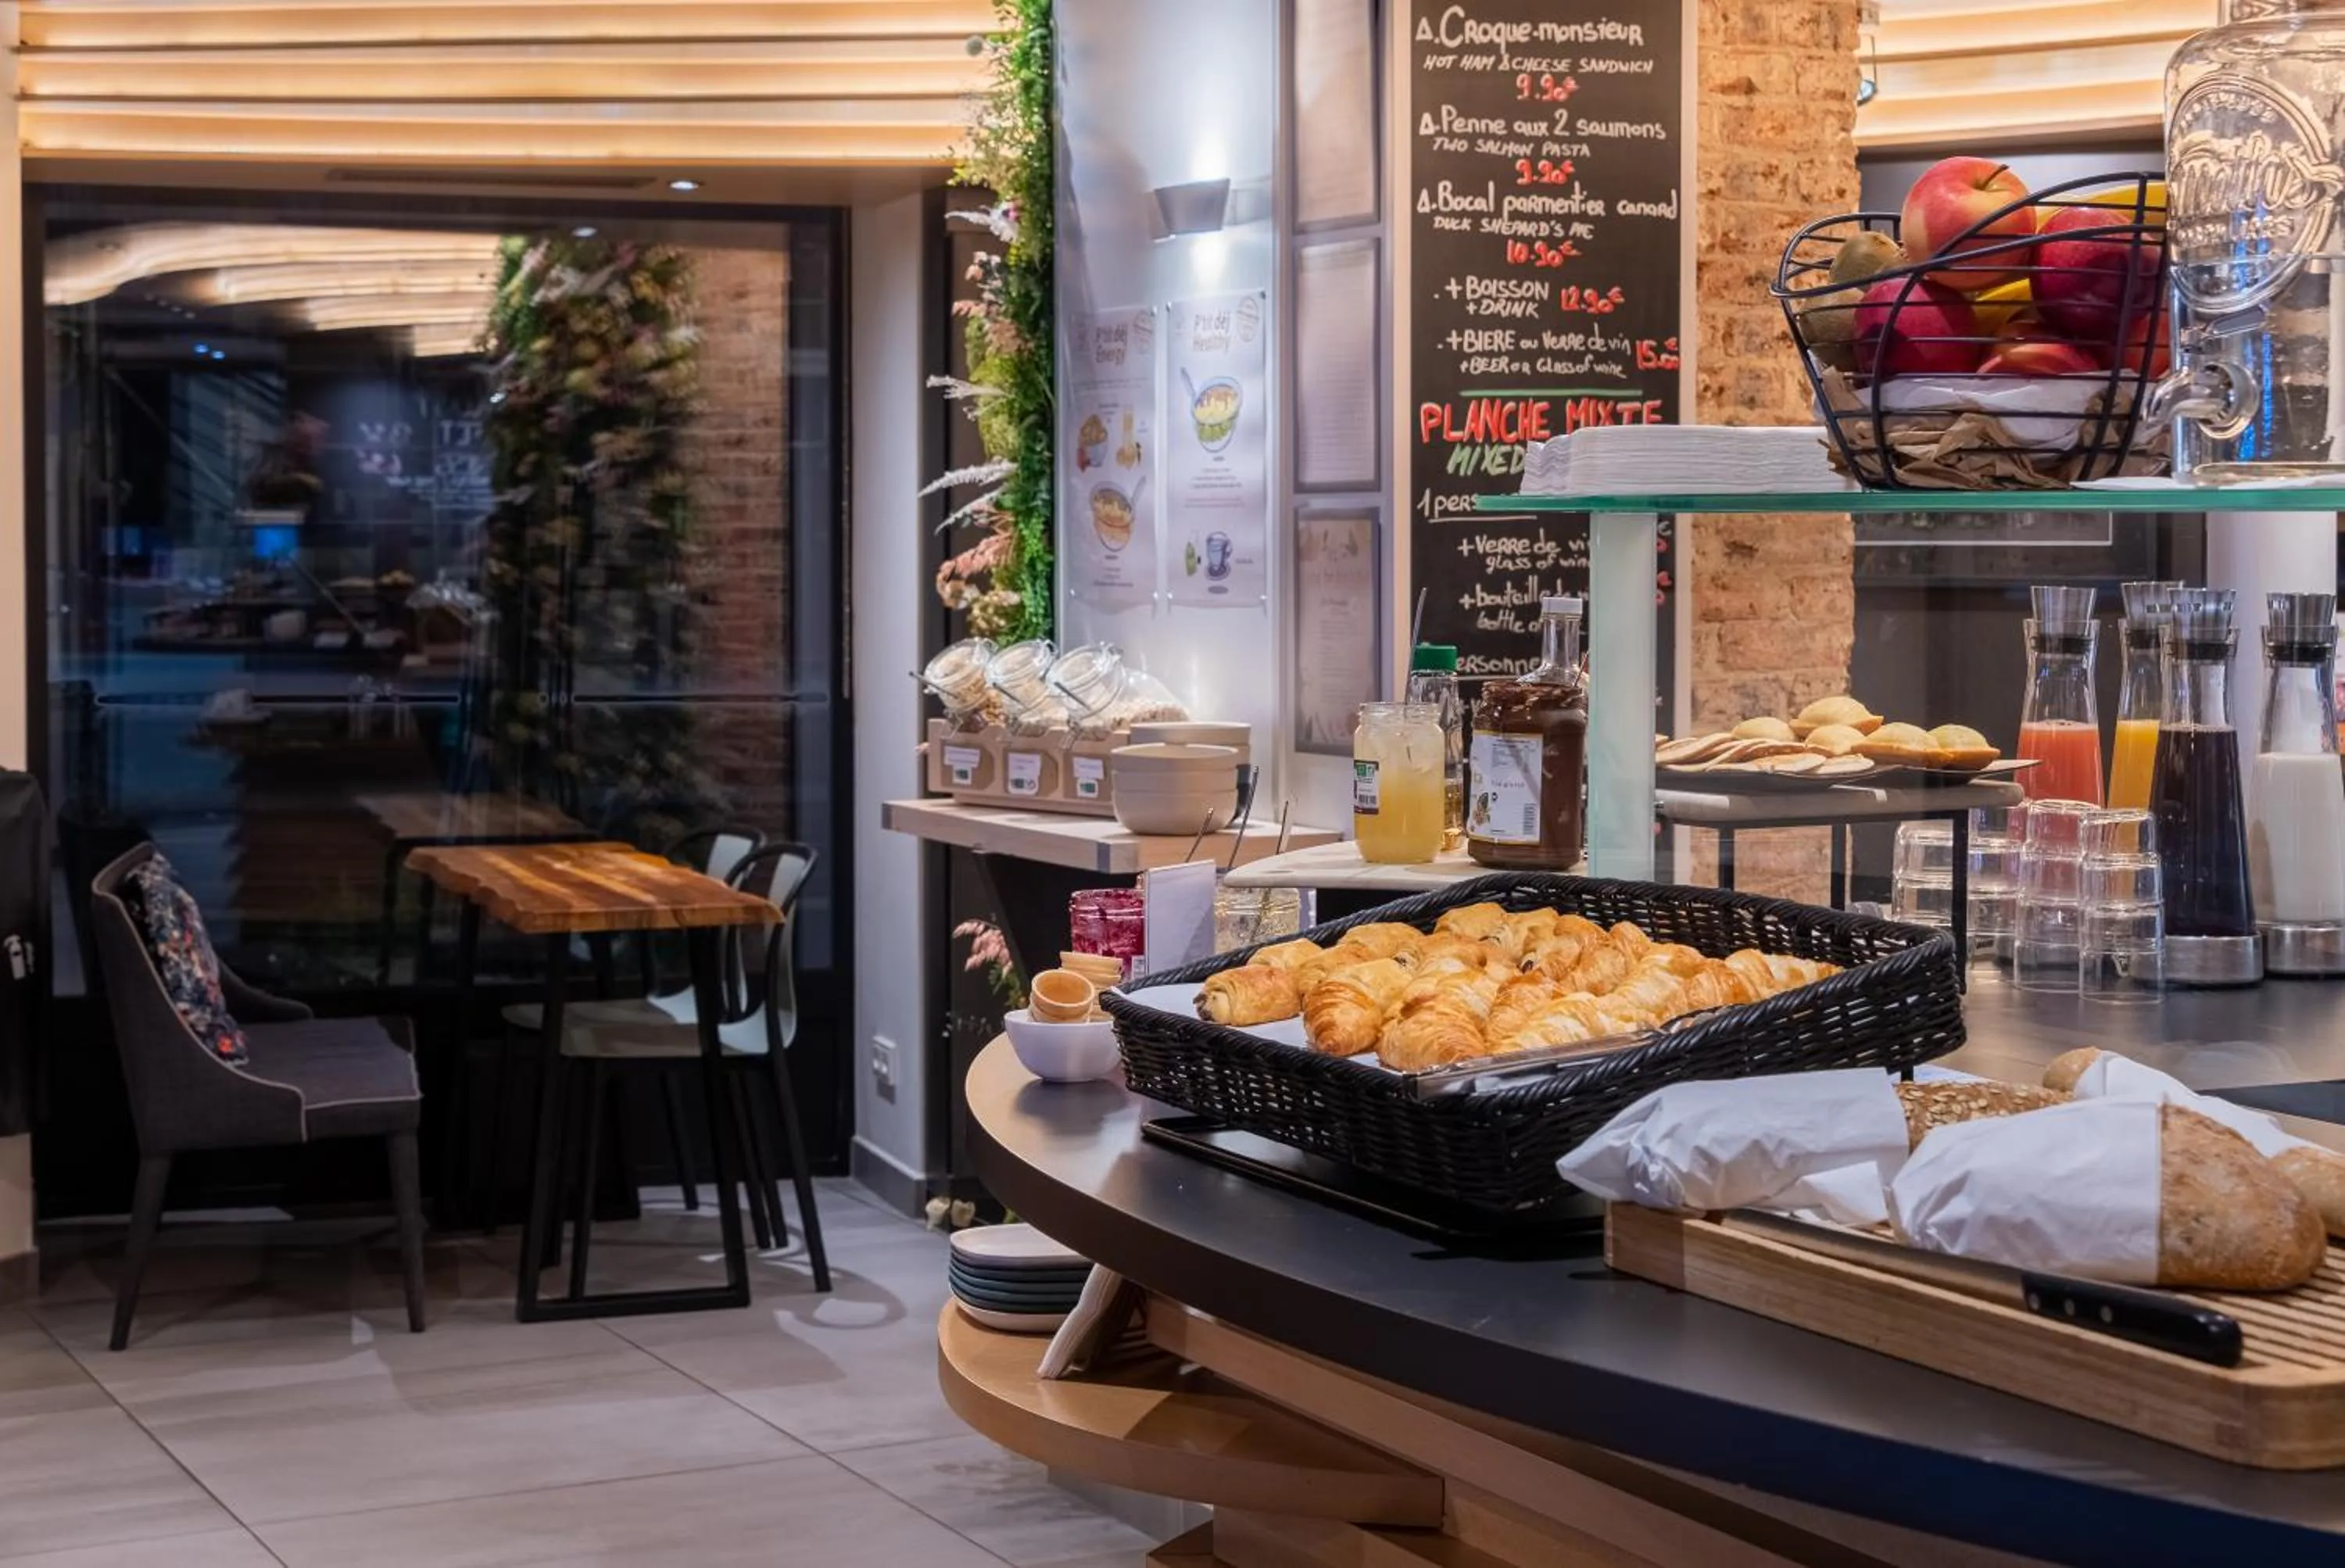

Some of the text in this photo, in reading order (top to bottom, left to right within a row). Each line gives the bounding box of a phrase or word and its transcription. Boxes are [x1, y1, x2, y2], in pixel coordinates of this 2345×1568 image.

[1423, 54, 1458, 70] HOT
[1459, 54, 1495, 70] HAM
[1579, 59, 1653, 73] SANDWICH
[1441, 105, 1667, 139] Penne aux 2 saumons
[1432, 137, 1591, 158] TWO SALMON PASTA
[1437, 180, 1494, 212] Bocal
[1434, 216, 1472, 231] DUCK
[1520, 338, 1539, 349] ou
[1587, 321, 1606, 352] de
[1608, 332, 1631, 356] vin
[1420, 397, 1663, 443] PLANCHE MIXTE
[1446, 442, 1525, 477] MIXED
[1534, 527, 1562, 554] de
[1568, 532, 1591, 552] vi
[1486, 552, 1591, 575] glass of win
[1477, 610, 1524, 633] bottle
